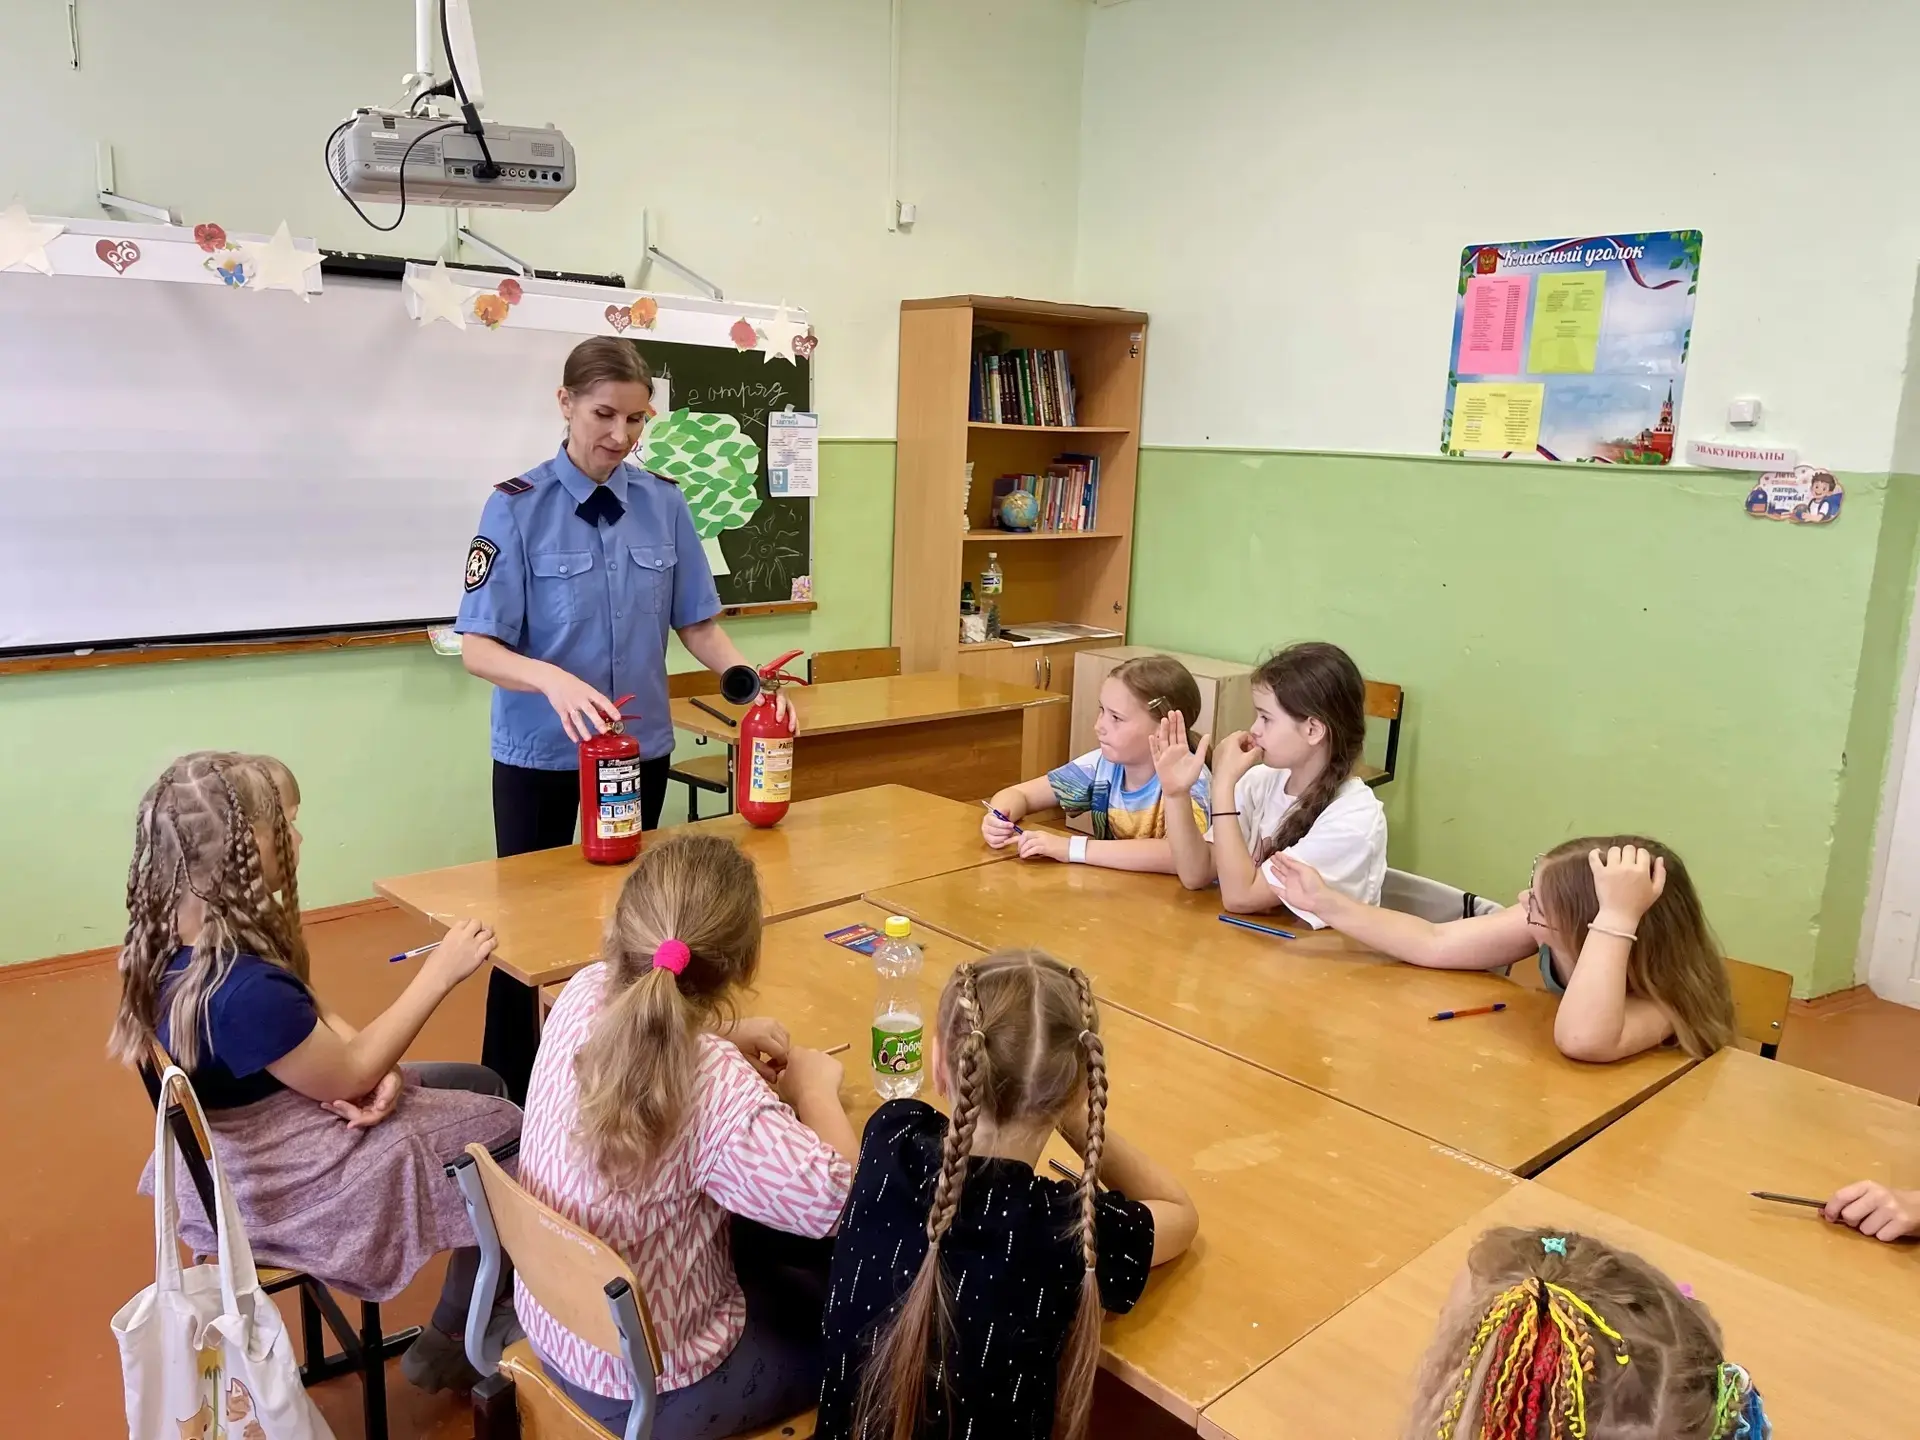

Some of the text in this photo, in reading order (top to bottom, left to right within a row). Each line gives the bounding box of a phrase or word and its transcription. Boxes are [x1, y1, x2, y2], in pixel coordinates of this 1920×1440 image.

[1502, 245, 1645, 268] Классный уголок
[687, 381, 788, 408] 2 отряд
[1694, 444, 1785, 461] ЭВАКУИРОВАНЫ
[1773, 493, 1805, 502] дружба!
